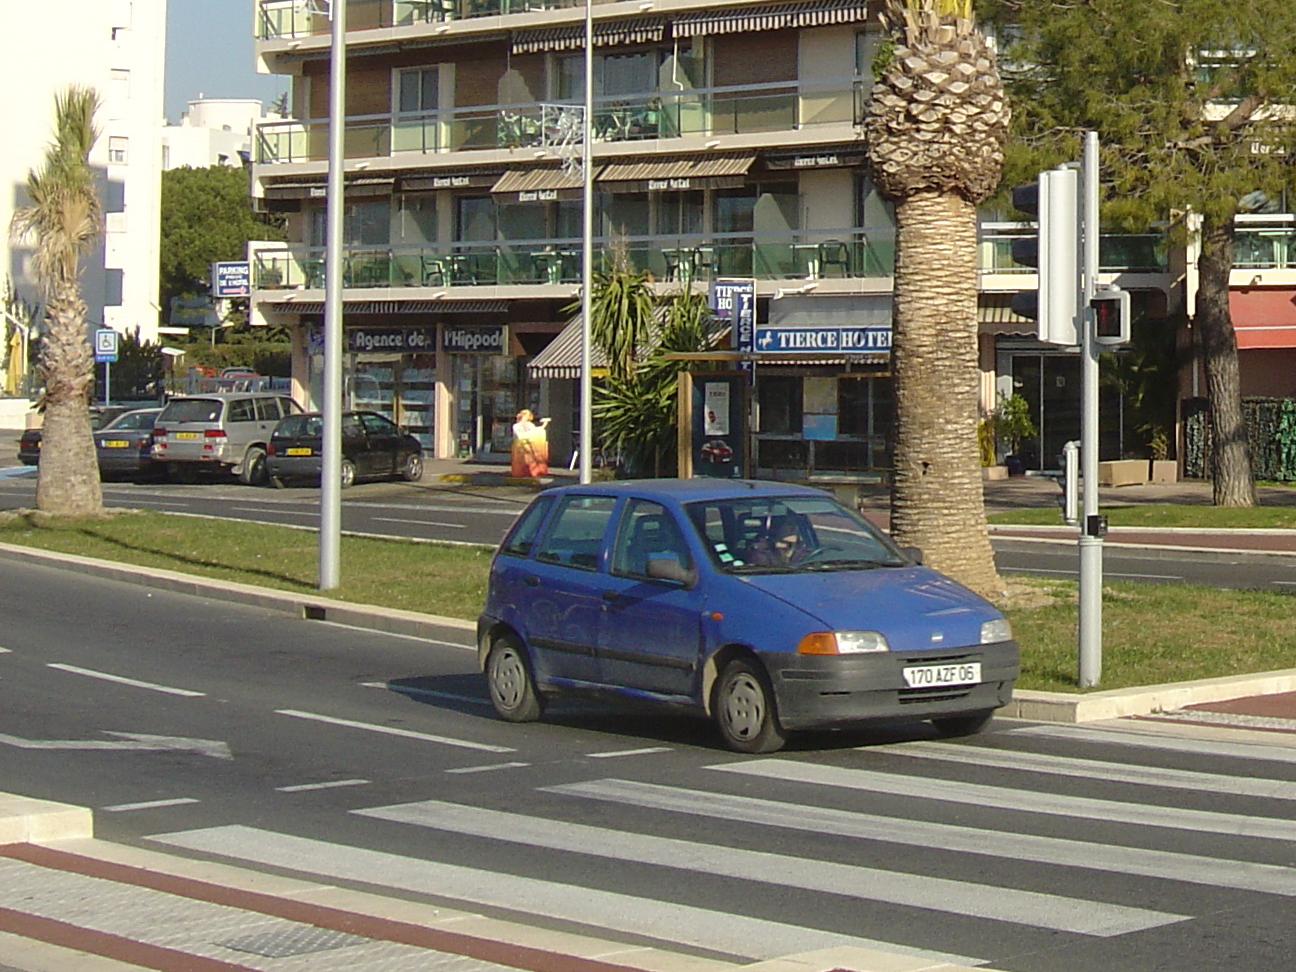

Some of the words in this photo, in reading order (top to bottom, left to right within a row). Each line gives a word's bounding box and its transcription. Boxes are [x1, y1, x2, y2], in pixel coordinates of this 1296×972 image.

[356, 331, 403, 351] Agence
[408, 330, 424, 347] de
[777, 330, 837, 349] TIERCE
[911, 669, 933, 685] 170
[936, 667, 957, 683] AZF
[959, 665, 974, 681] 06
